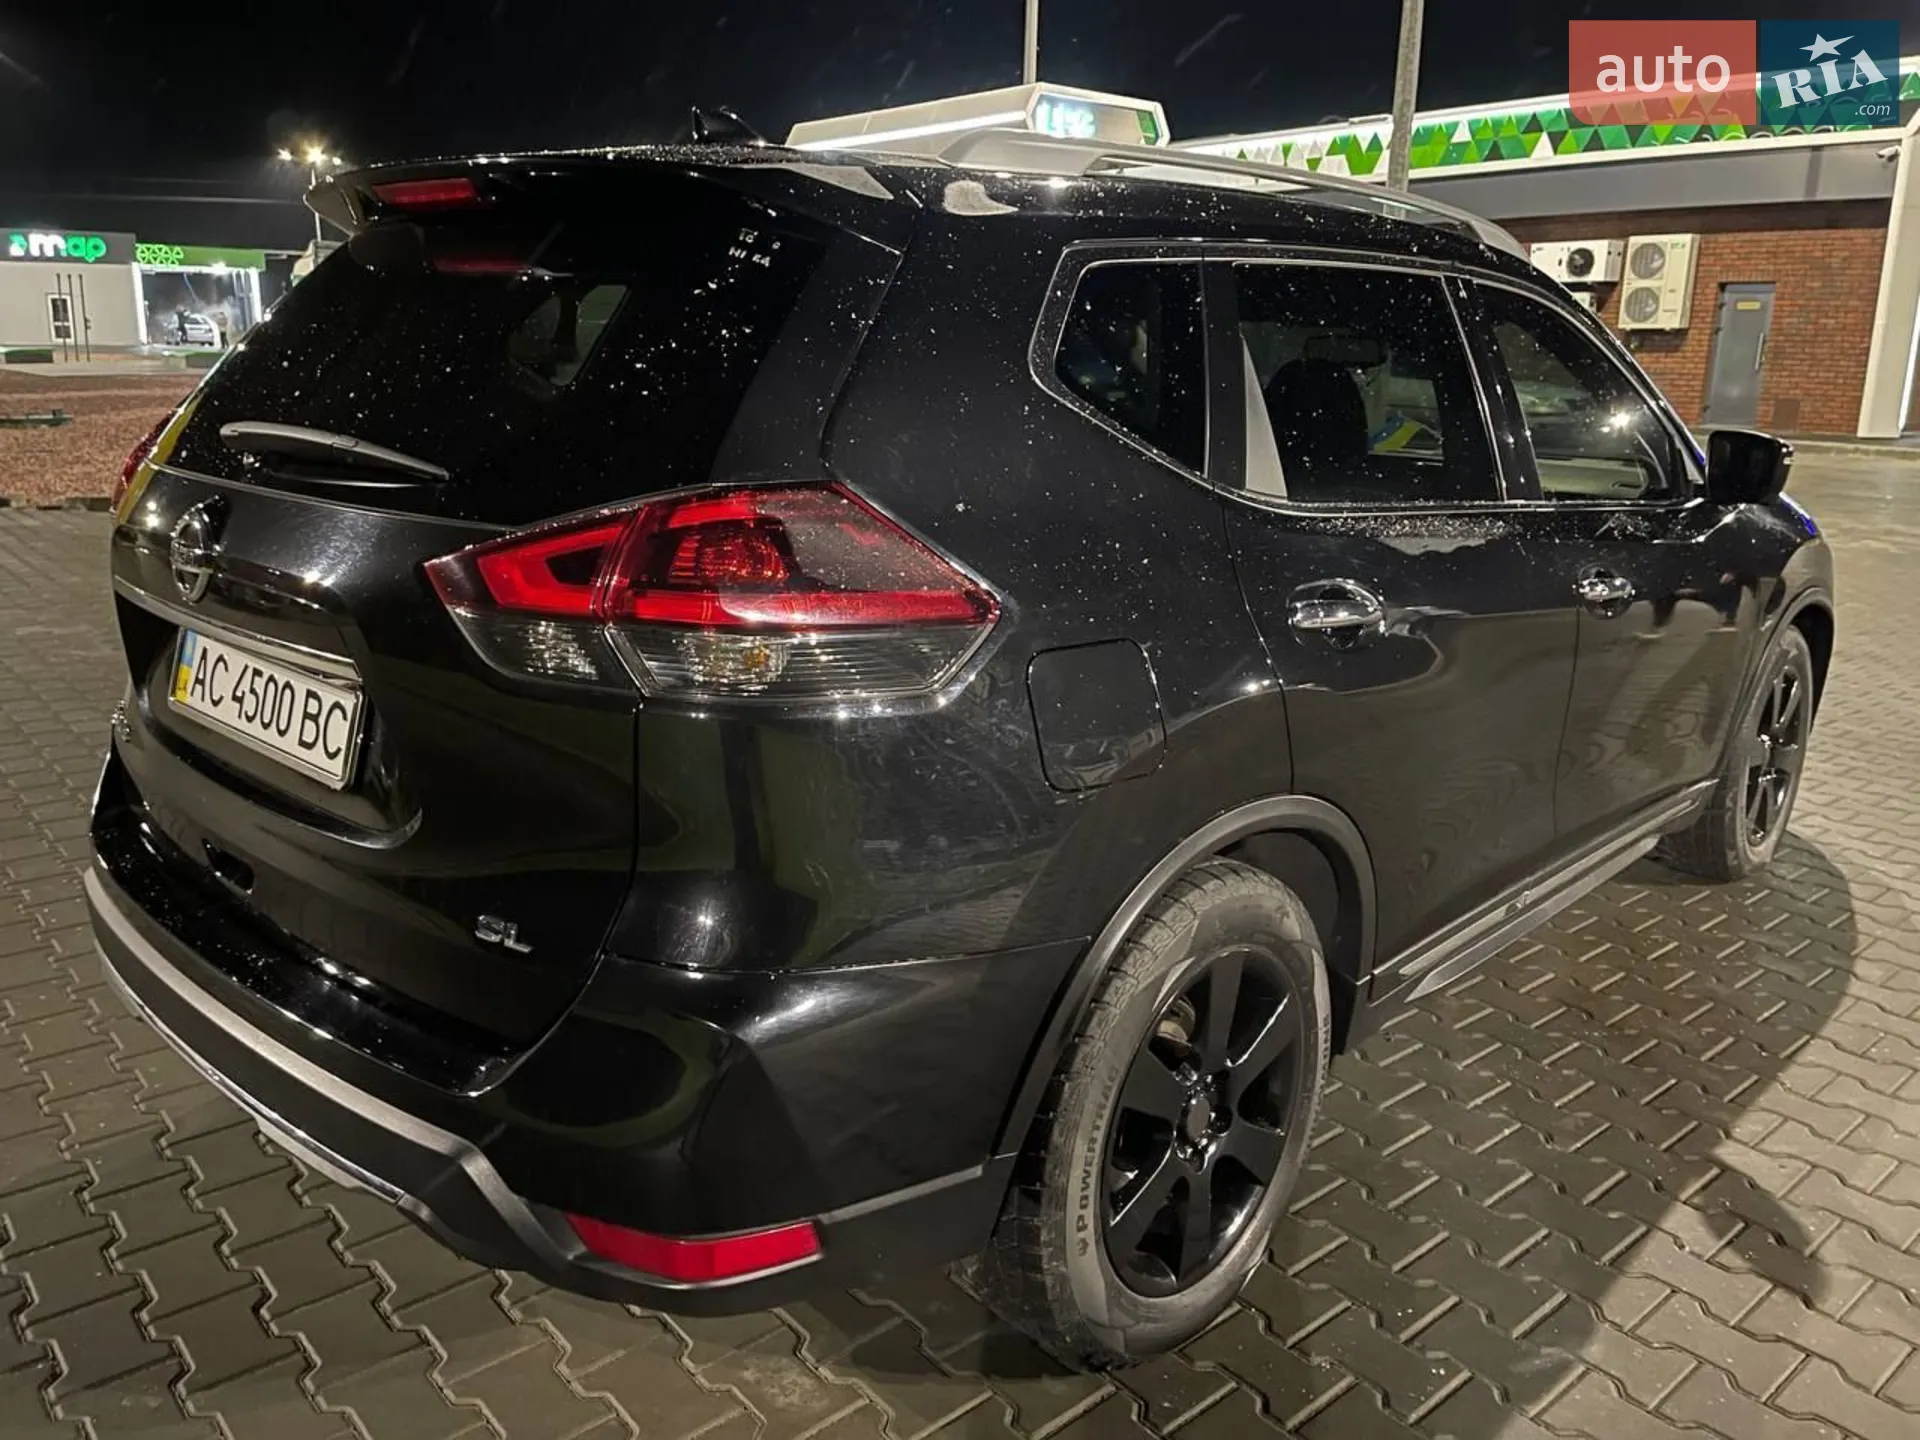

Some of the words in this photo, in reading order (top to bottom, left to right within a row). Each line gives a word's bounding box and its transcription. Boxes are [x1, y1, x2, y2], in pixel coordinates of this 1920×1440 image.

[190, 646, 229, 708] AC
[231, 663, 296, 739] 4500
[298, 687, 348, 761] BC
[475, 915, 533, 953] SL
